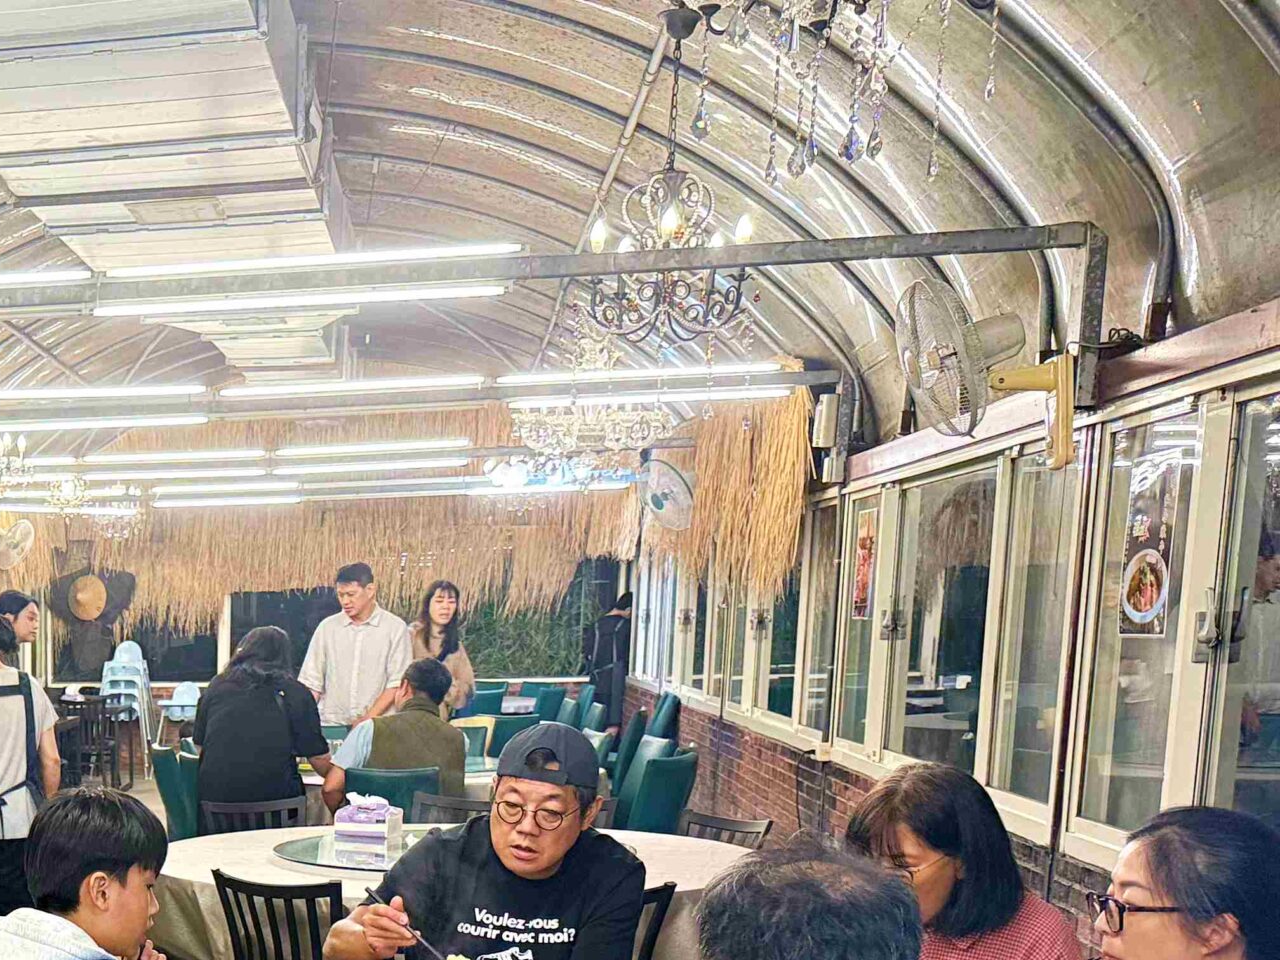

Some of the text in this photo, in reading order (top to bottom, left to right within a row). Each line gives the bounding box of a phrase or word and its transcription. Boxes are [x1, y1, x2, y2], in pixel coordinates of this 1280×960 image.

[457, 922, 576, 944] courir avec moi?
